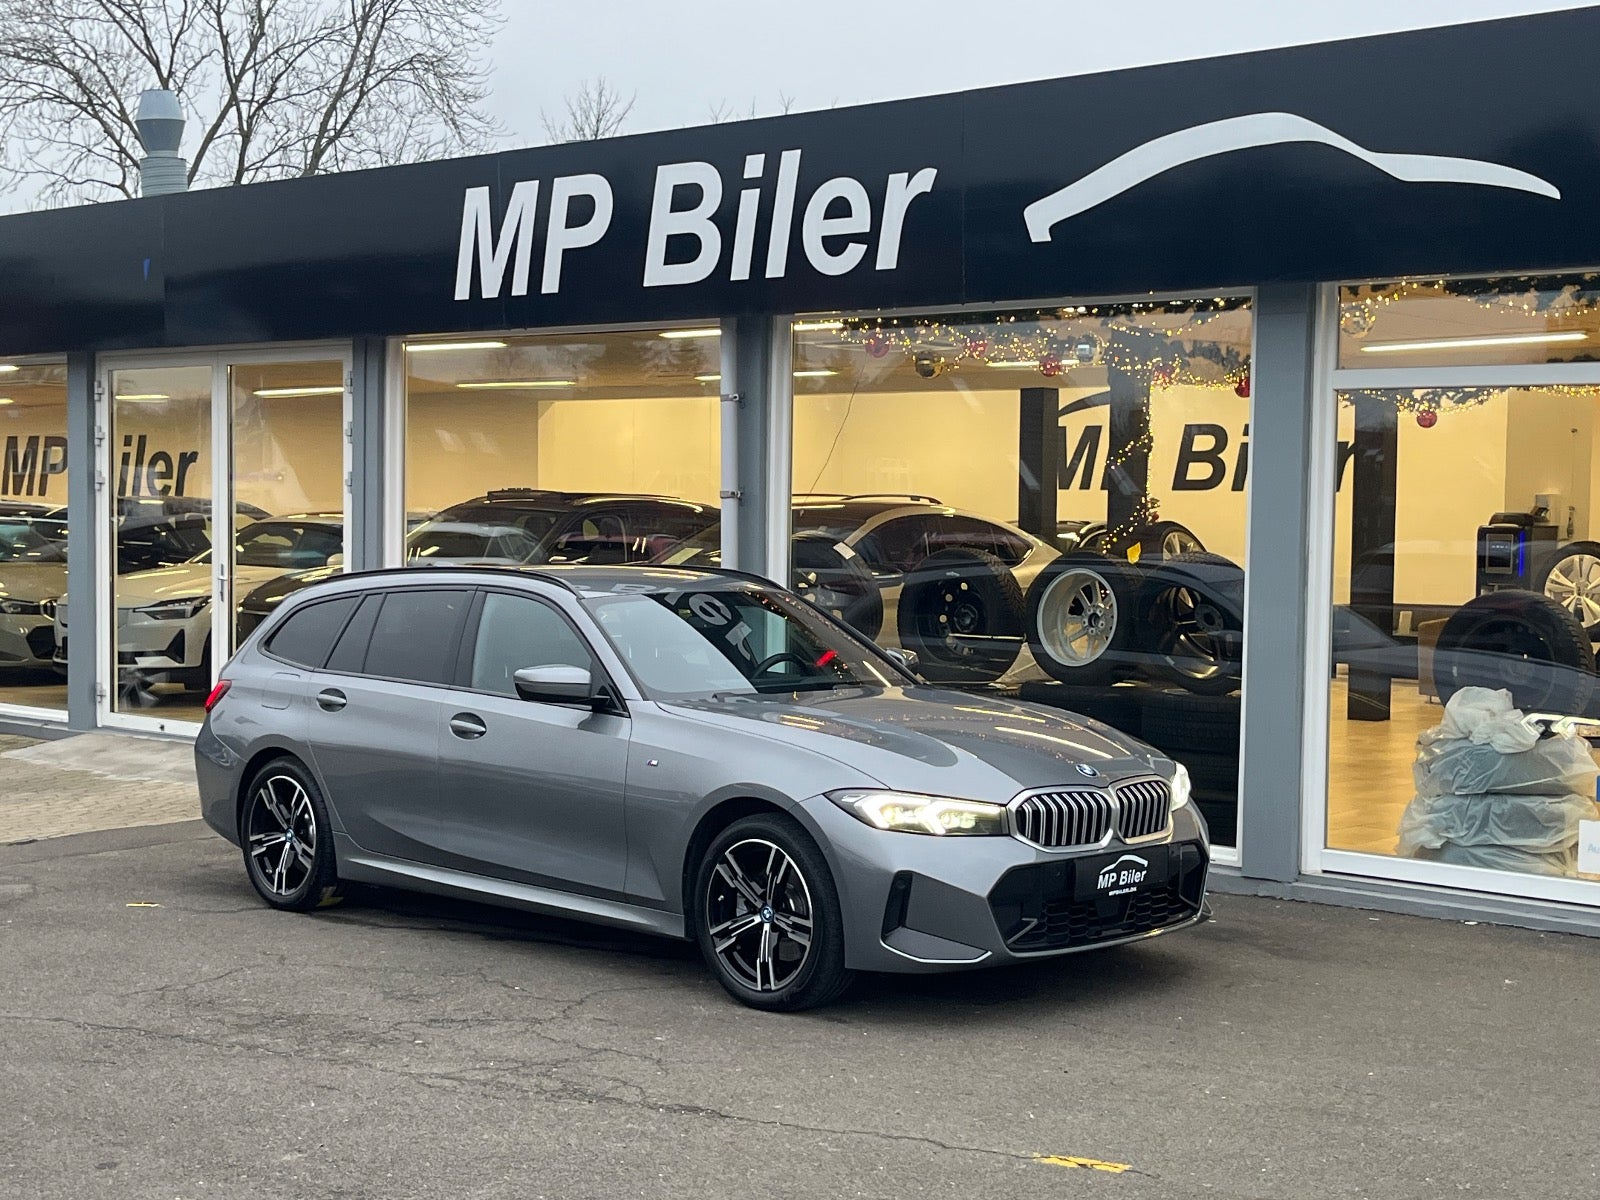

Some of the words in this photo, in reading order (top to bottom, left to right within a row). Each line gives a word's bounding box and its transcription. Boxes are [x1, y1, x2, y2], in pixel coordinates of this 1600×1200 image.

[454, 173, 613, 300] MP
[642, 149, 938, 287] Biler
[2, 435, 68, 497] MP
[118, 434, 199, 498] iler
[1097, 872, 1117, 890] MP
[1119, 868, 1147, 886] Biler
